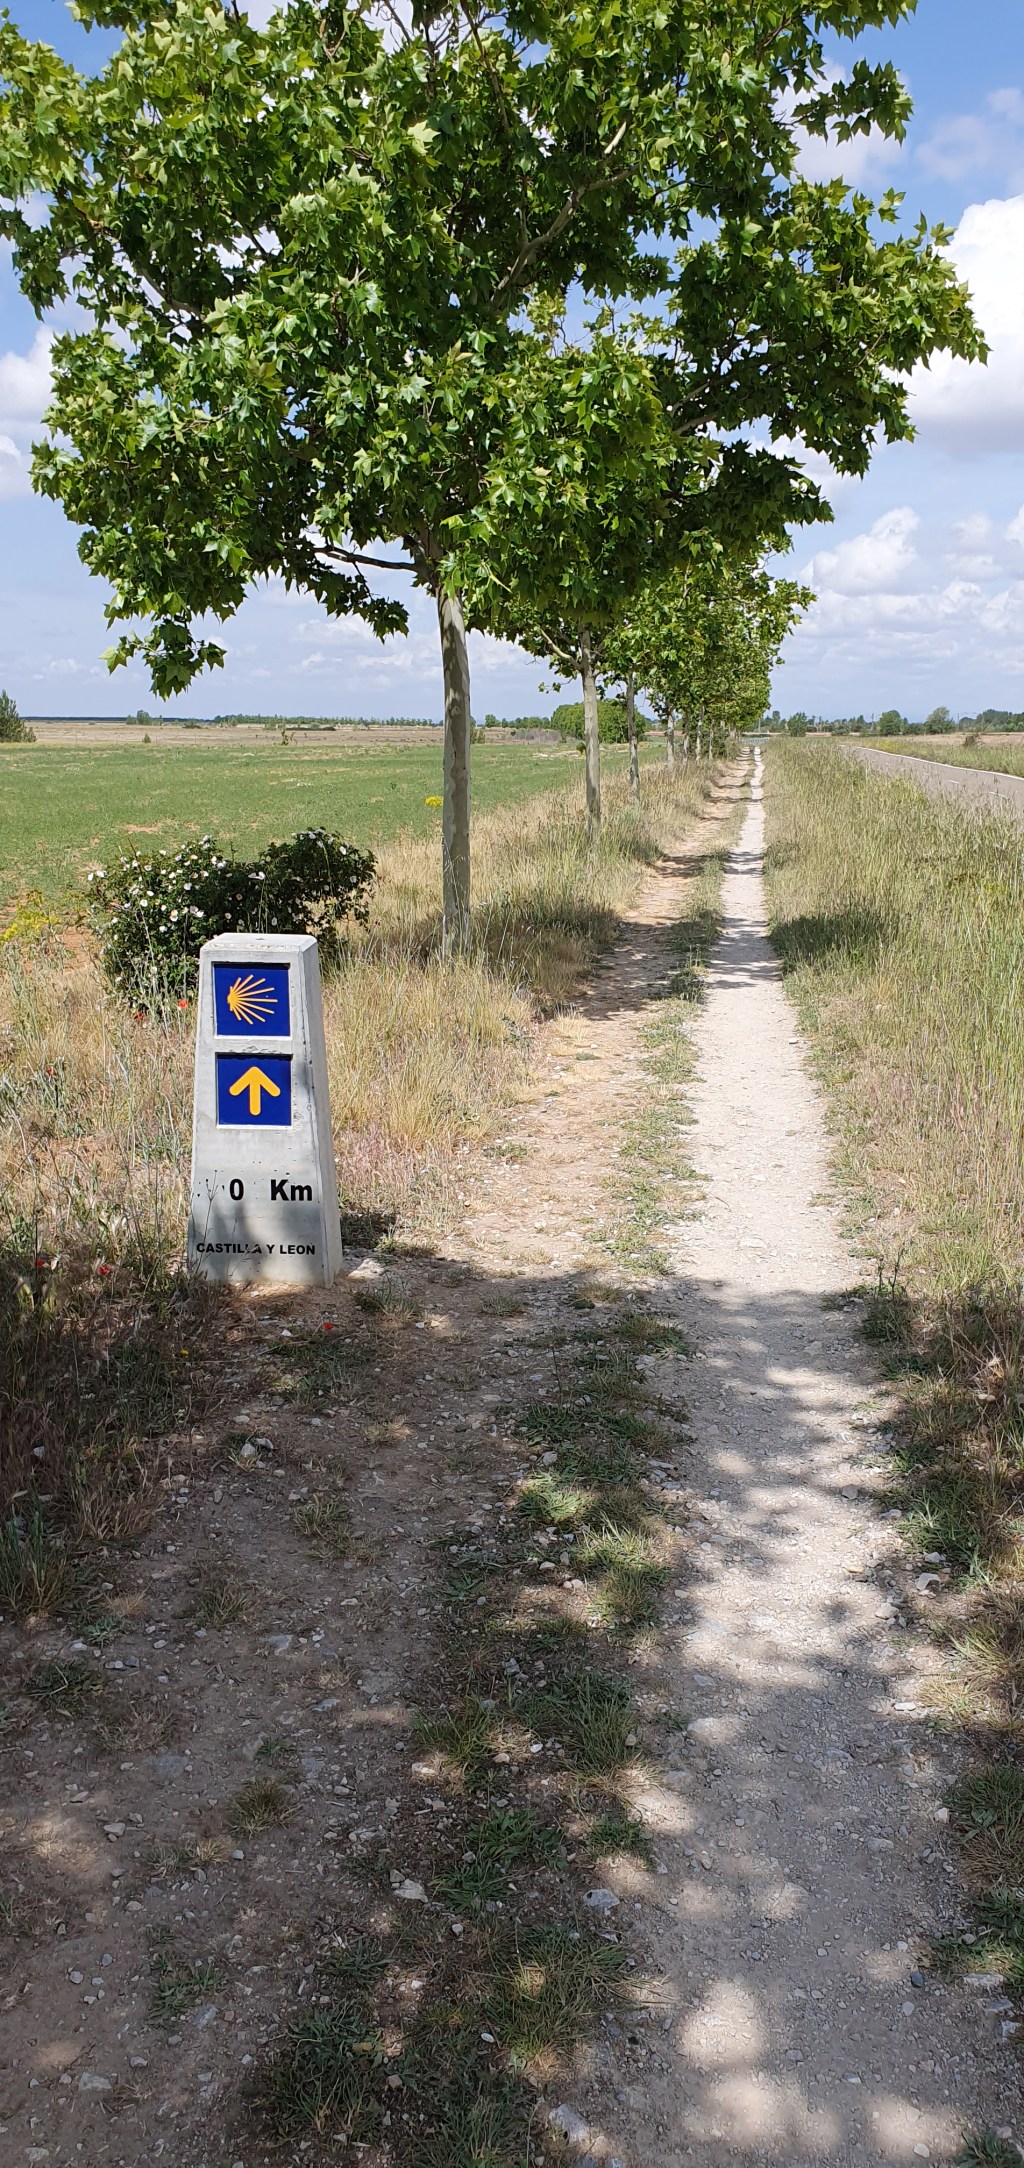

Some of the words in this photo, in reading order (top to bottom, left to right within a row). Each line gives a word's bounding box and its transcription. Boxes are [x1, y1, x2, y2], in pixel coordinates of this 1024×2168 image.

[229, 1178, 244, 1201] 0
[270, 1179, 313, 1201] Km
[266, 1244, 275, 1254] Y
[280, 1244, 315, 1255] LEON
